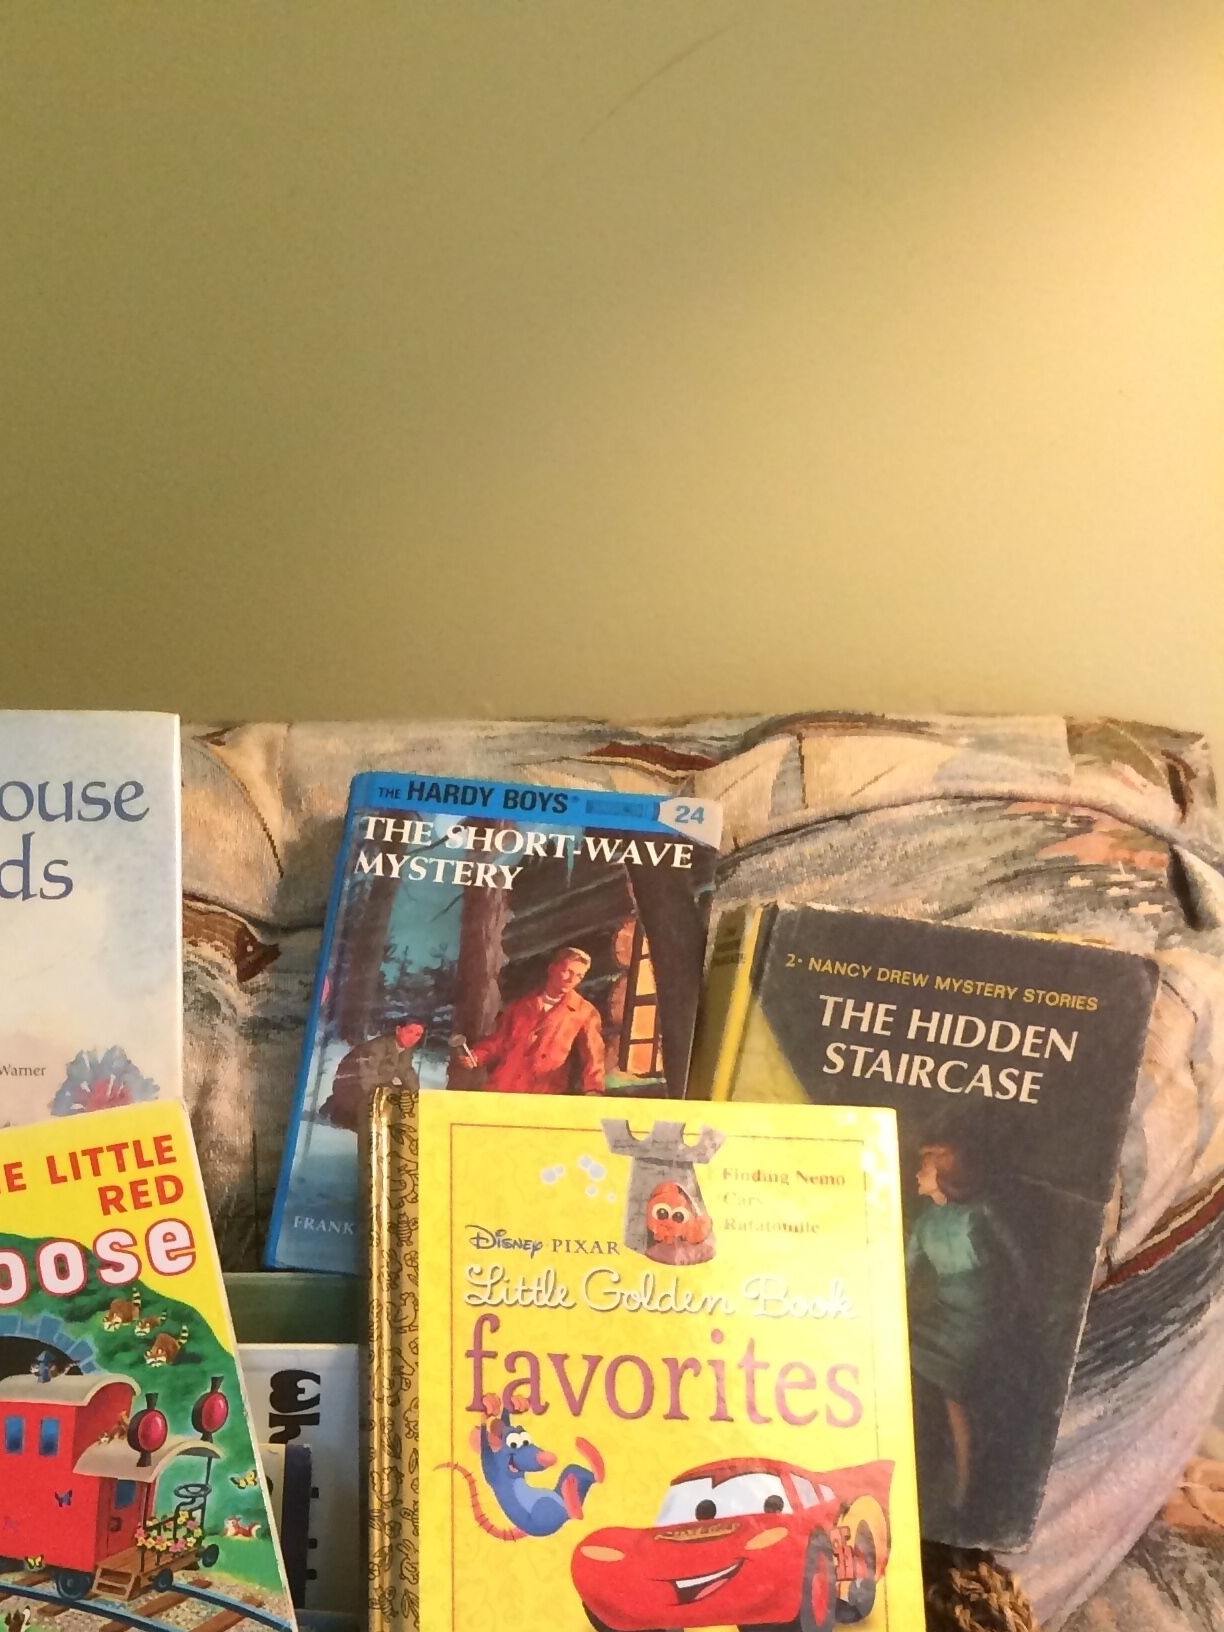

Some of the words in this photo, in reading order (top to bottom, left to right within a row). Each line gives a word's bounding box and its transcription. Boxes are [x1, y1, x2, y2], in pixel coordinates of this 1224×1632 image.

[378, 786, 401, 800] THE
[406, 780, 495, 808] HARDY
[502, 791, 568, 814] BOYS
[675, 804, 705, 825] 24
[361, 815, 434, 847] THE
[445, 824, 695, 869] SHORT-WAVE
[352, 851, 525, 890] MYSTERY
[808, 957, 873, 979] NANCY
[876, 967, 929, 988] DREW
[934, 975, 1019, 1001] MYSTERY
[1022, 988, 1099, 1012] STORIES
[819, 994, 897, 1037] THE
[906, 1008, 1079, 1062] HIDDEN
[822, 1041, 1044, 1105] STAIRCASE
[46, 1134, 177, 1185] LITTLE
[722, 1167, 790, 1186] Finding
[796, 1170, 846, 1187] Nemo
[98, 1174, 184, 1216] RED
[551, 1238, 620, 1256] PIXAR
[464, 1264, 577, 1309] Little
[583, 1268, 737, 1315] Golden
[743, 1274, 858, 1319] Book
[464, 1313, 864, 1428] favorites
